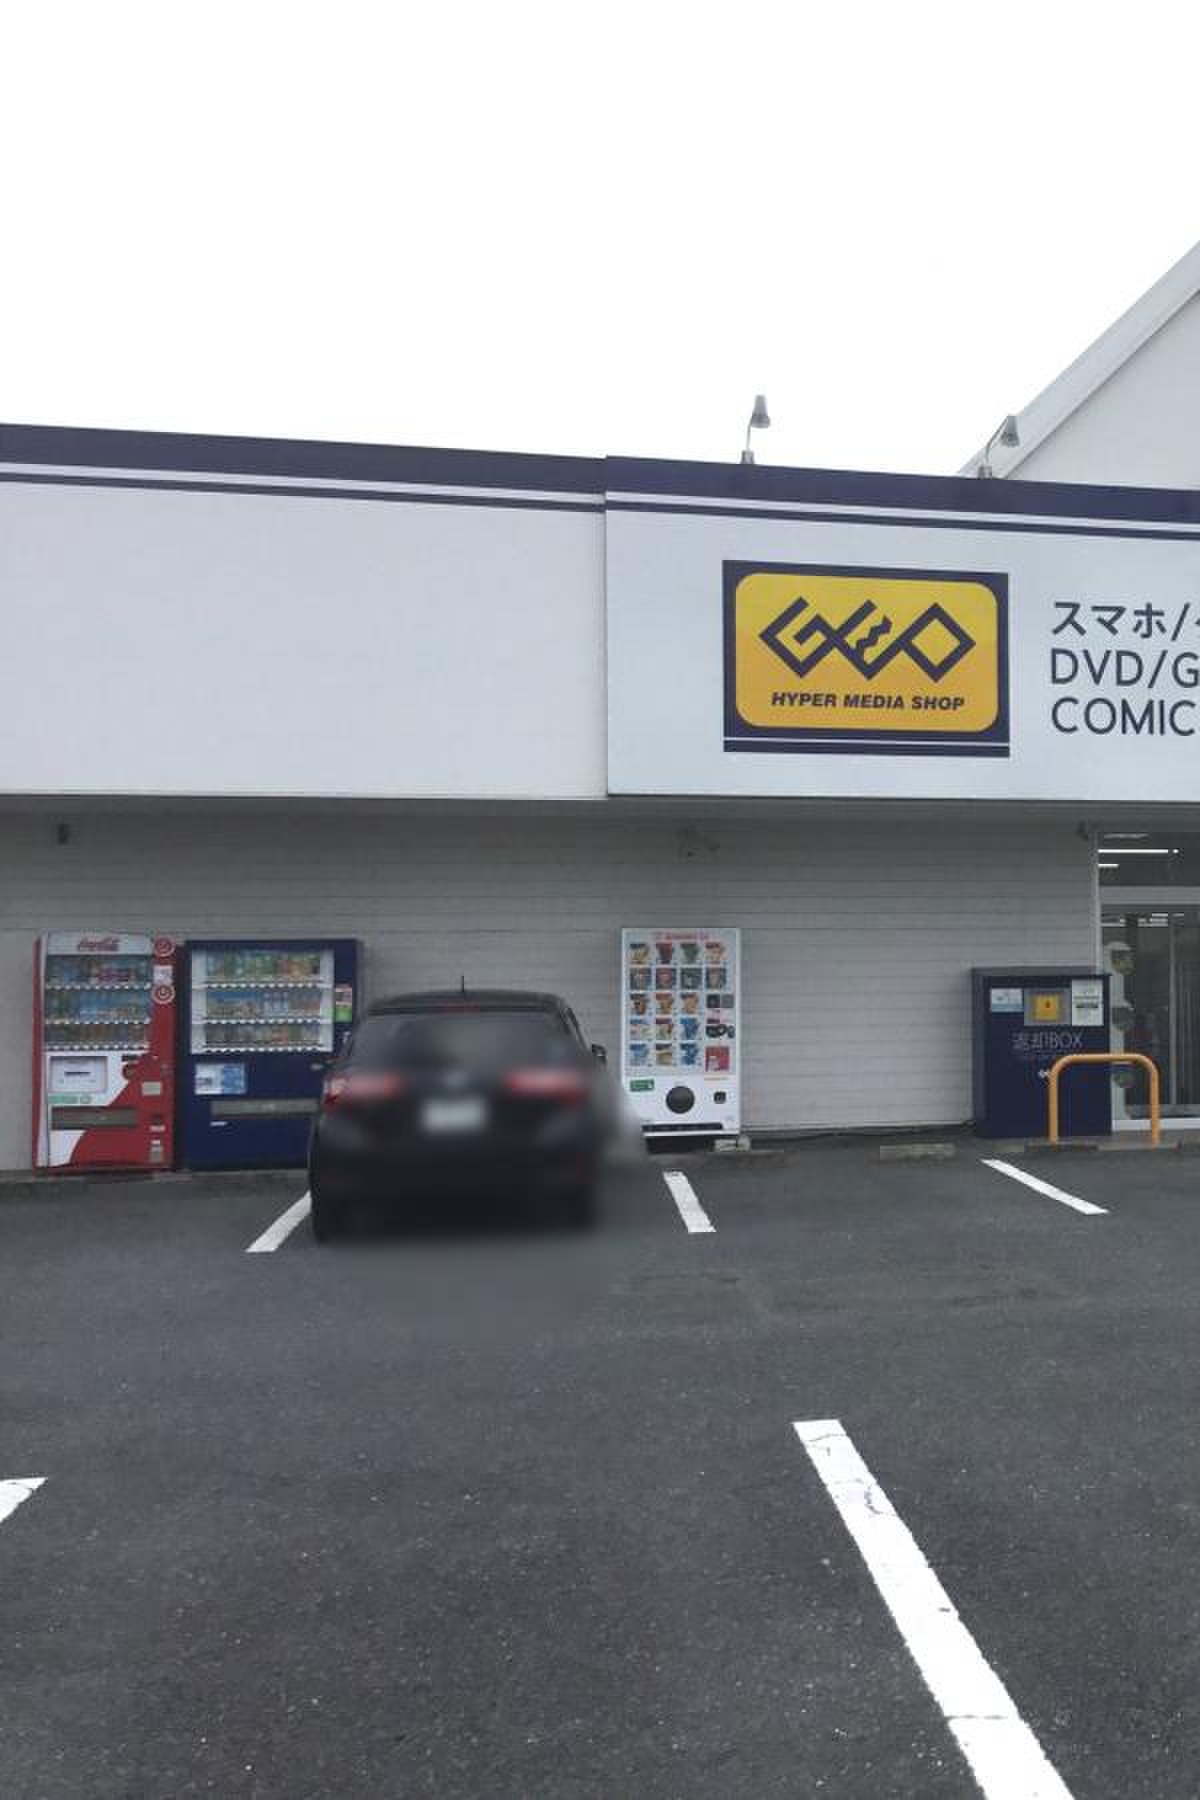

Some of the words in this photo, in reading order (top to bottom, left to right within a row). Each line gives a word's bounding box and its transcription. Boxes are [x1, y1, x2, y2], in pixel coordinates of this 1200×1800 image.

[758, 596, 976, 683] GEO
[771, 692, 837, 708] HYPER
[843, 693, 904, 710] MEDIA
[911, 696, 965, 711] SHOP
[1051, 697, 1197, 737] COMIC
